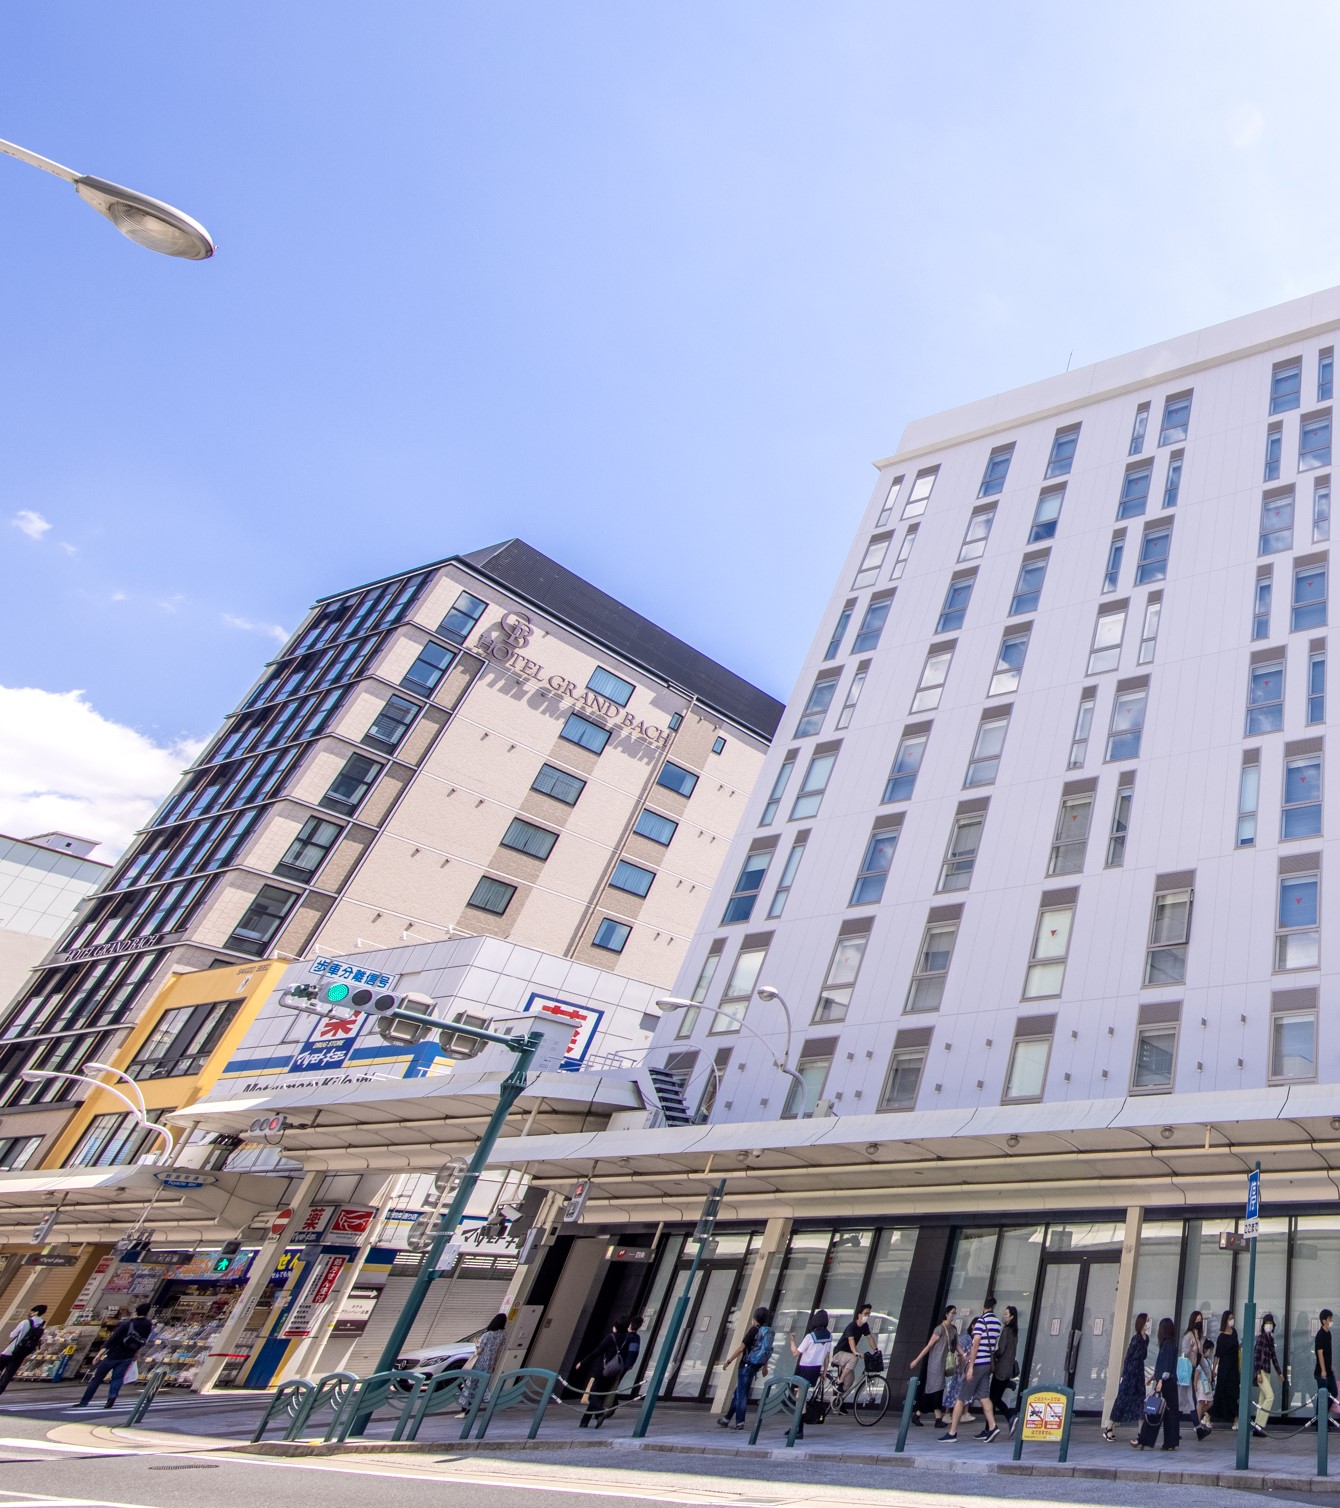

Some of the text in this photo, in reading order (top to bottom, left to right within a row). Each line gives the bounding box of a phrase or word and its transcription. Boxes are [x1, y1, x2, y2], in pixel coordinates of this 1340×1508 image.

[474, 634, 671, 747] HOTEL GRAND BACH
[66, 934, 159, 962] HOTEL GRAND BACH
[313, 959, 392, 988] 歩車分離信号
[302, 1207, 327, 1230] 薬
